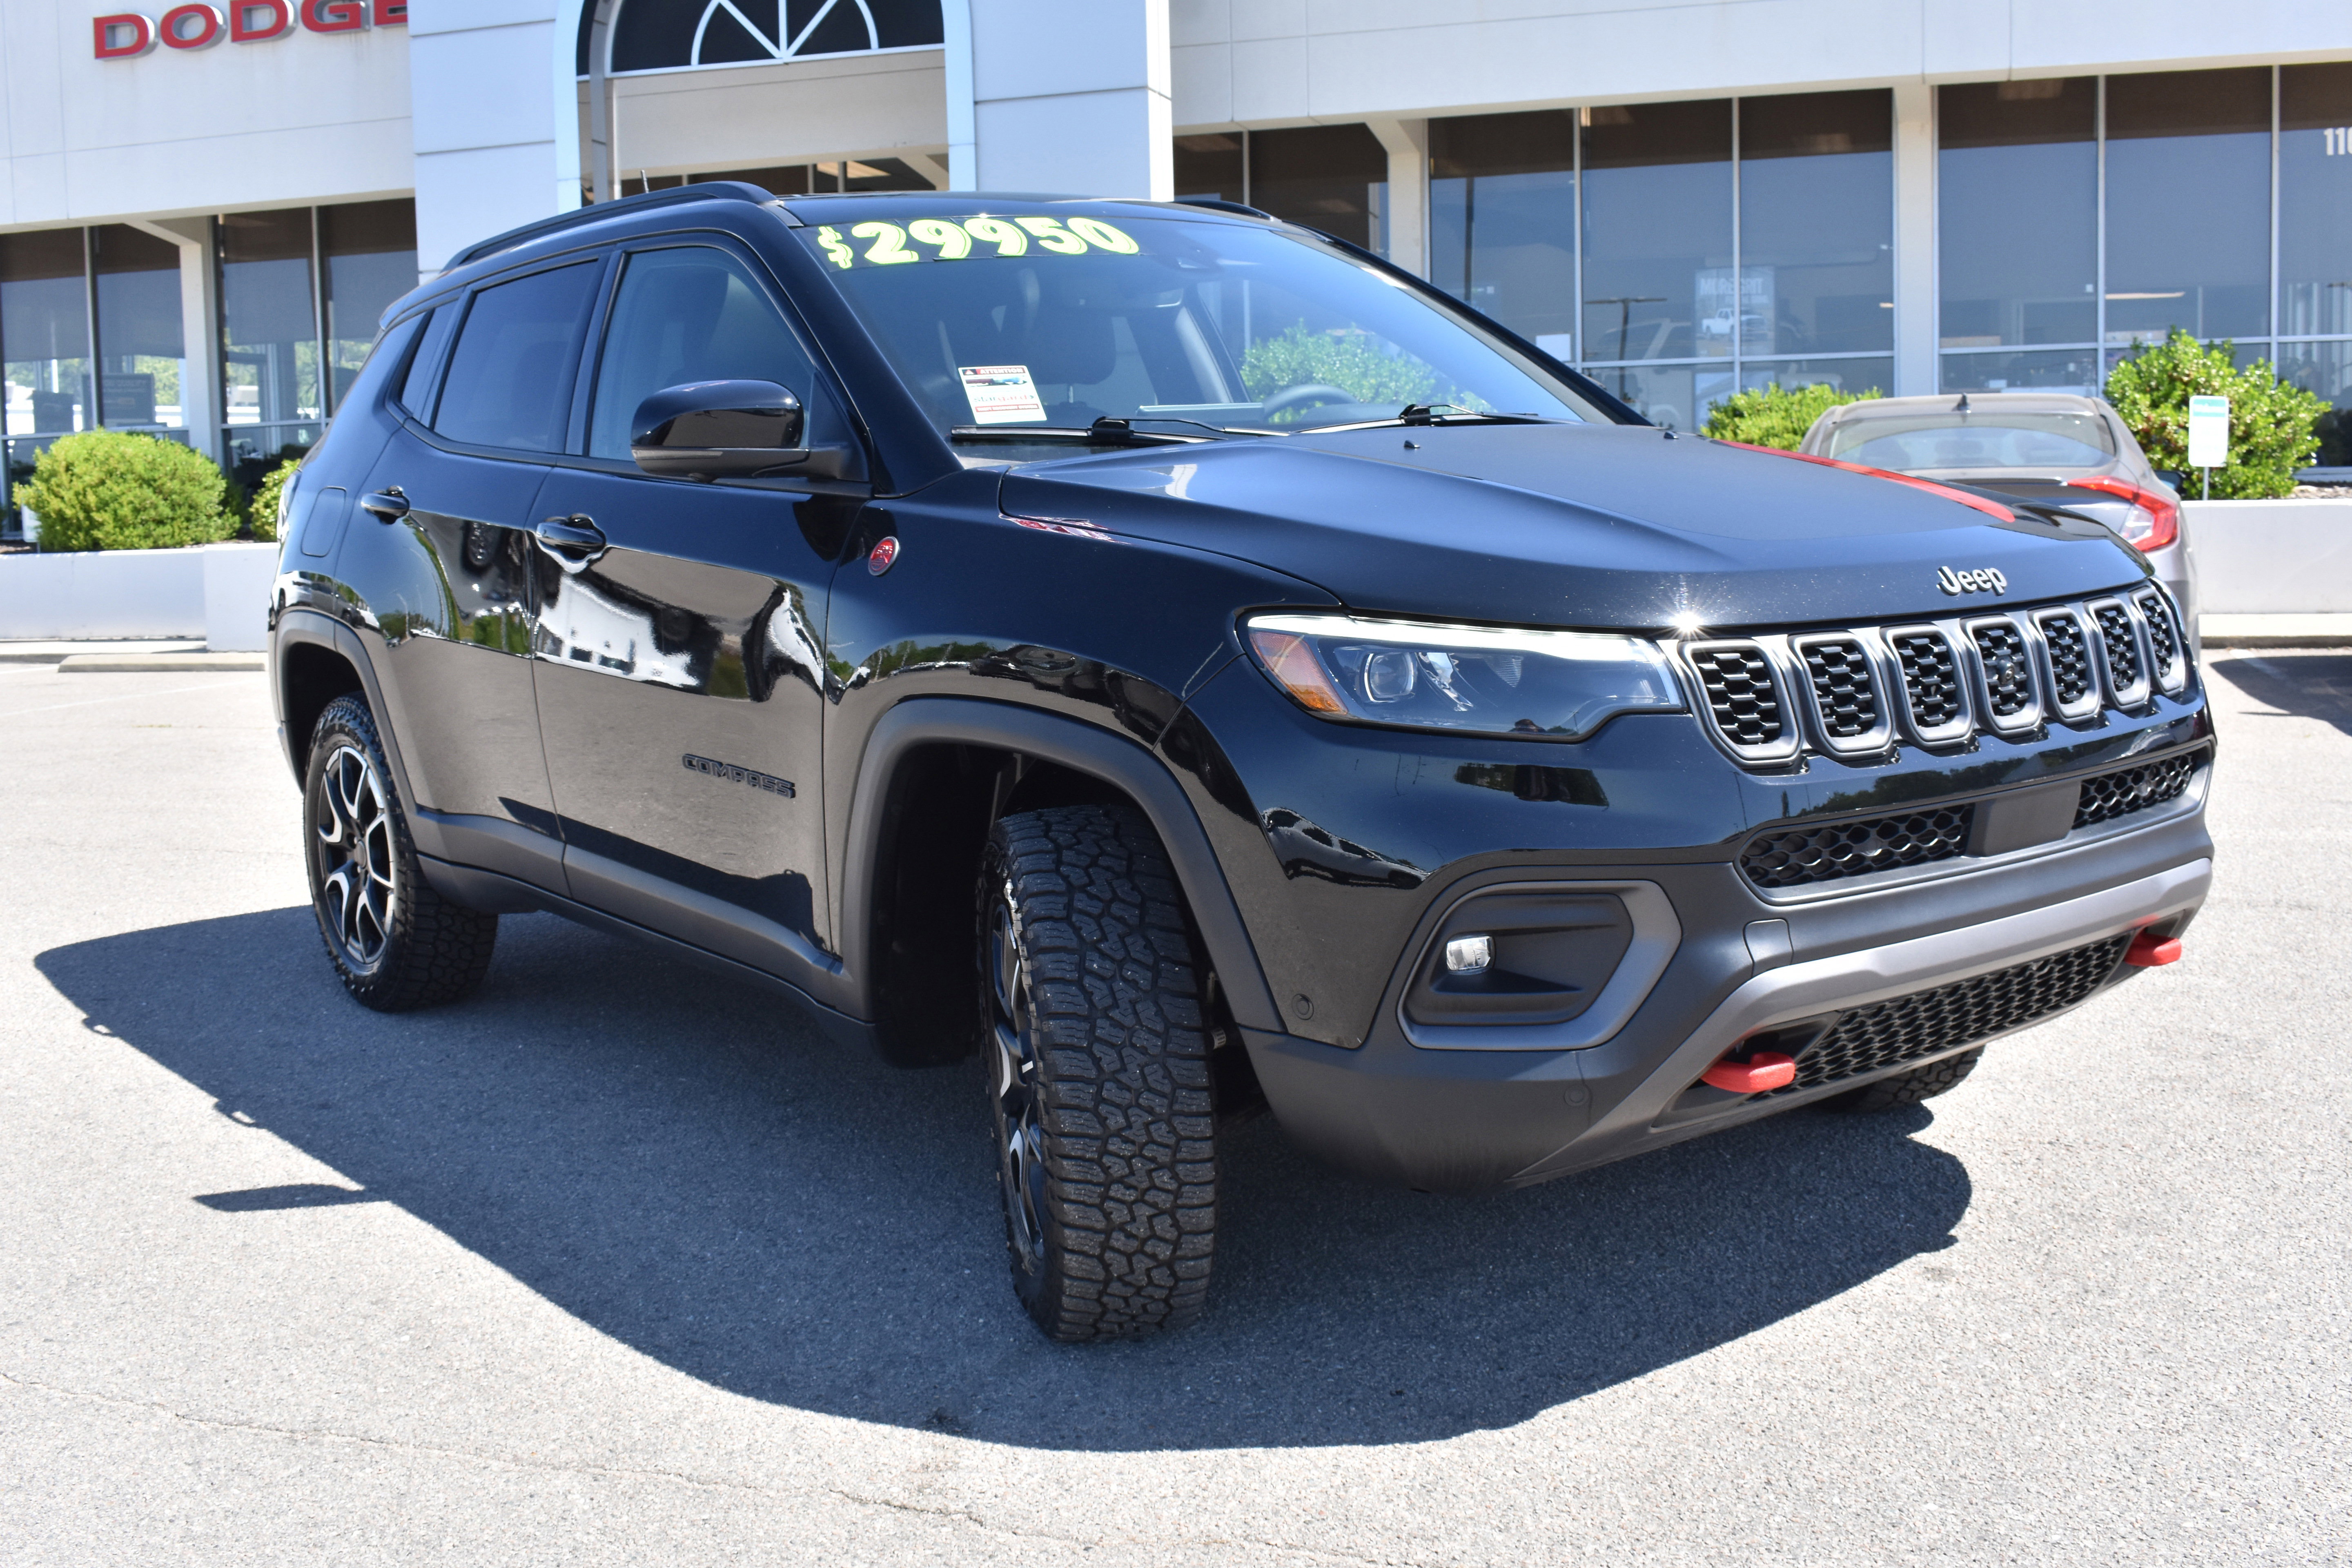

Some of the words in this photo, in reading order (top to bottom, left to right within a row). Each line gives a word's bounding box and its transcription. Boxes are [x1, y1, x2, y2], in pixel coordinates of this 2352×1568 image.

[818, 218, 1139, 269] $29950
[1936, 566, 2007, 596] Jeep
[682, 753, 796, 799] COMPASS
